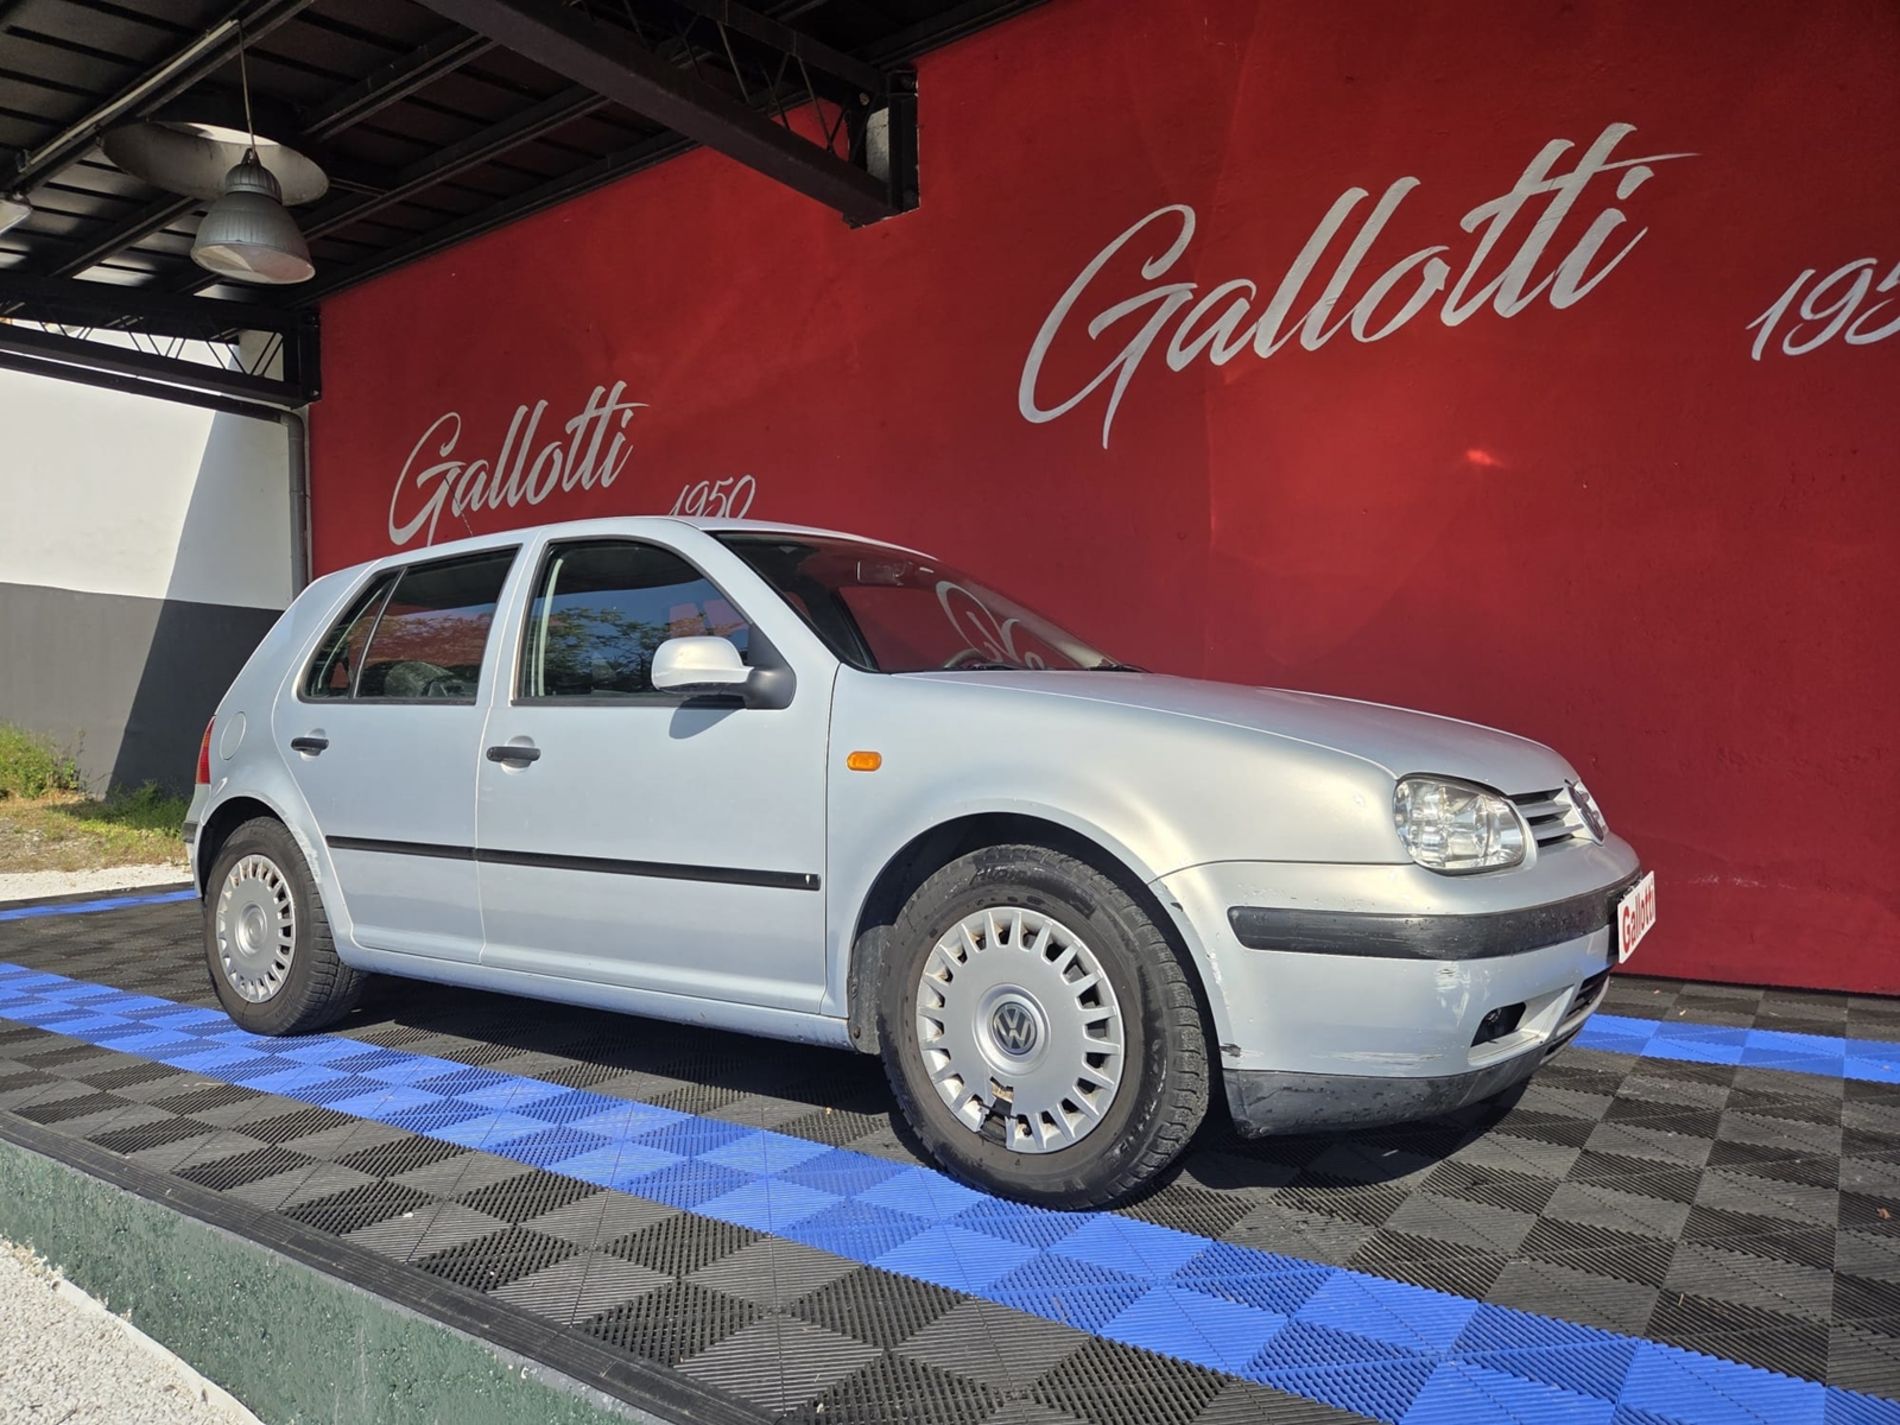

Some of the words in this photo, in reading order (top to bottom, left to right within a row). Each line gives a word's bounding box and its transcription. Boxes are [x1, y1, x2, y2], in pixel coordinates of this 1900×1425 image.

[1018, 121, 1700, 449] Gallotti
[388, 380, 649, 546] Gallotti
[668, 474, 756, 519] 1950
[1622, 878, 1655, 954] Gallotti
